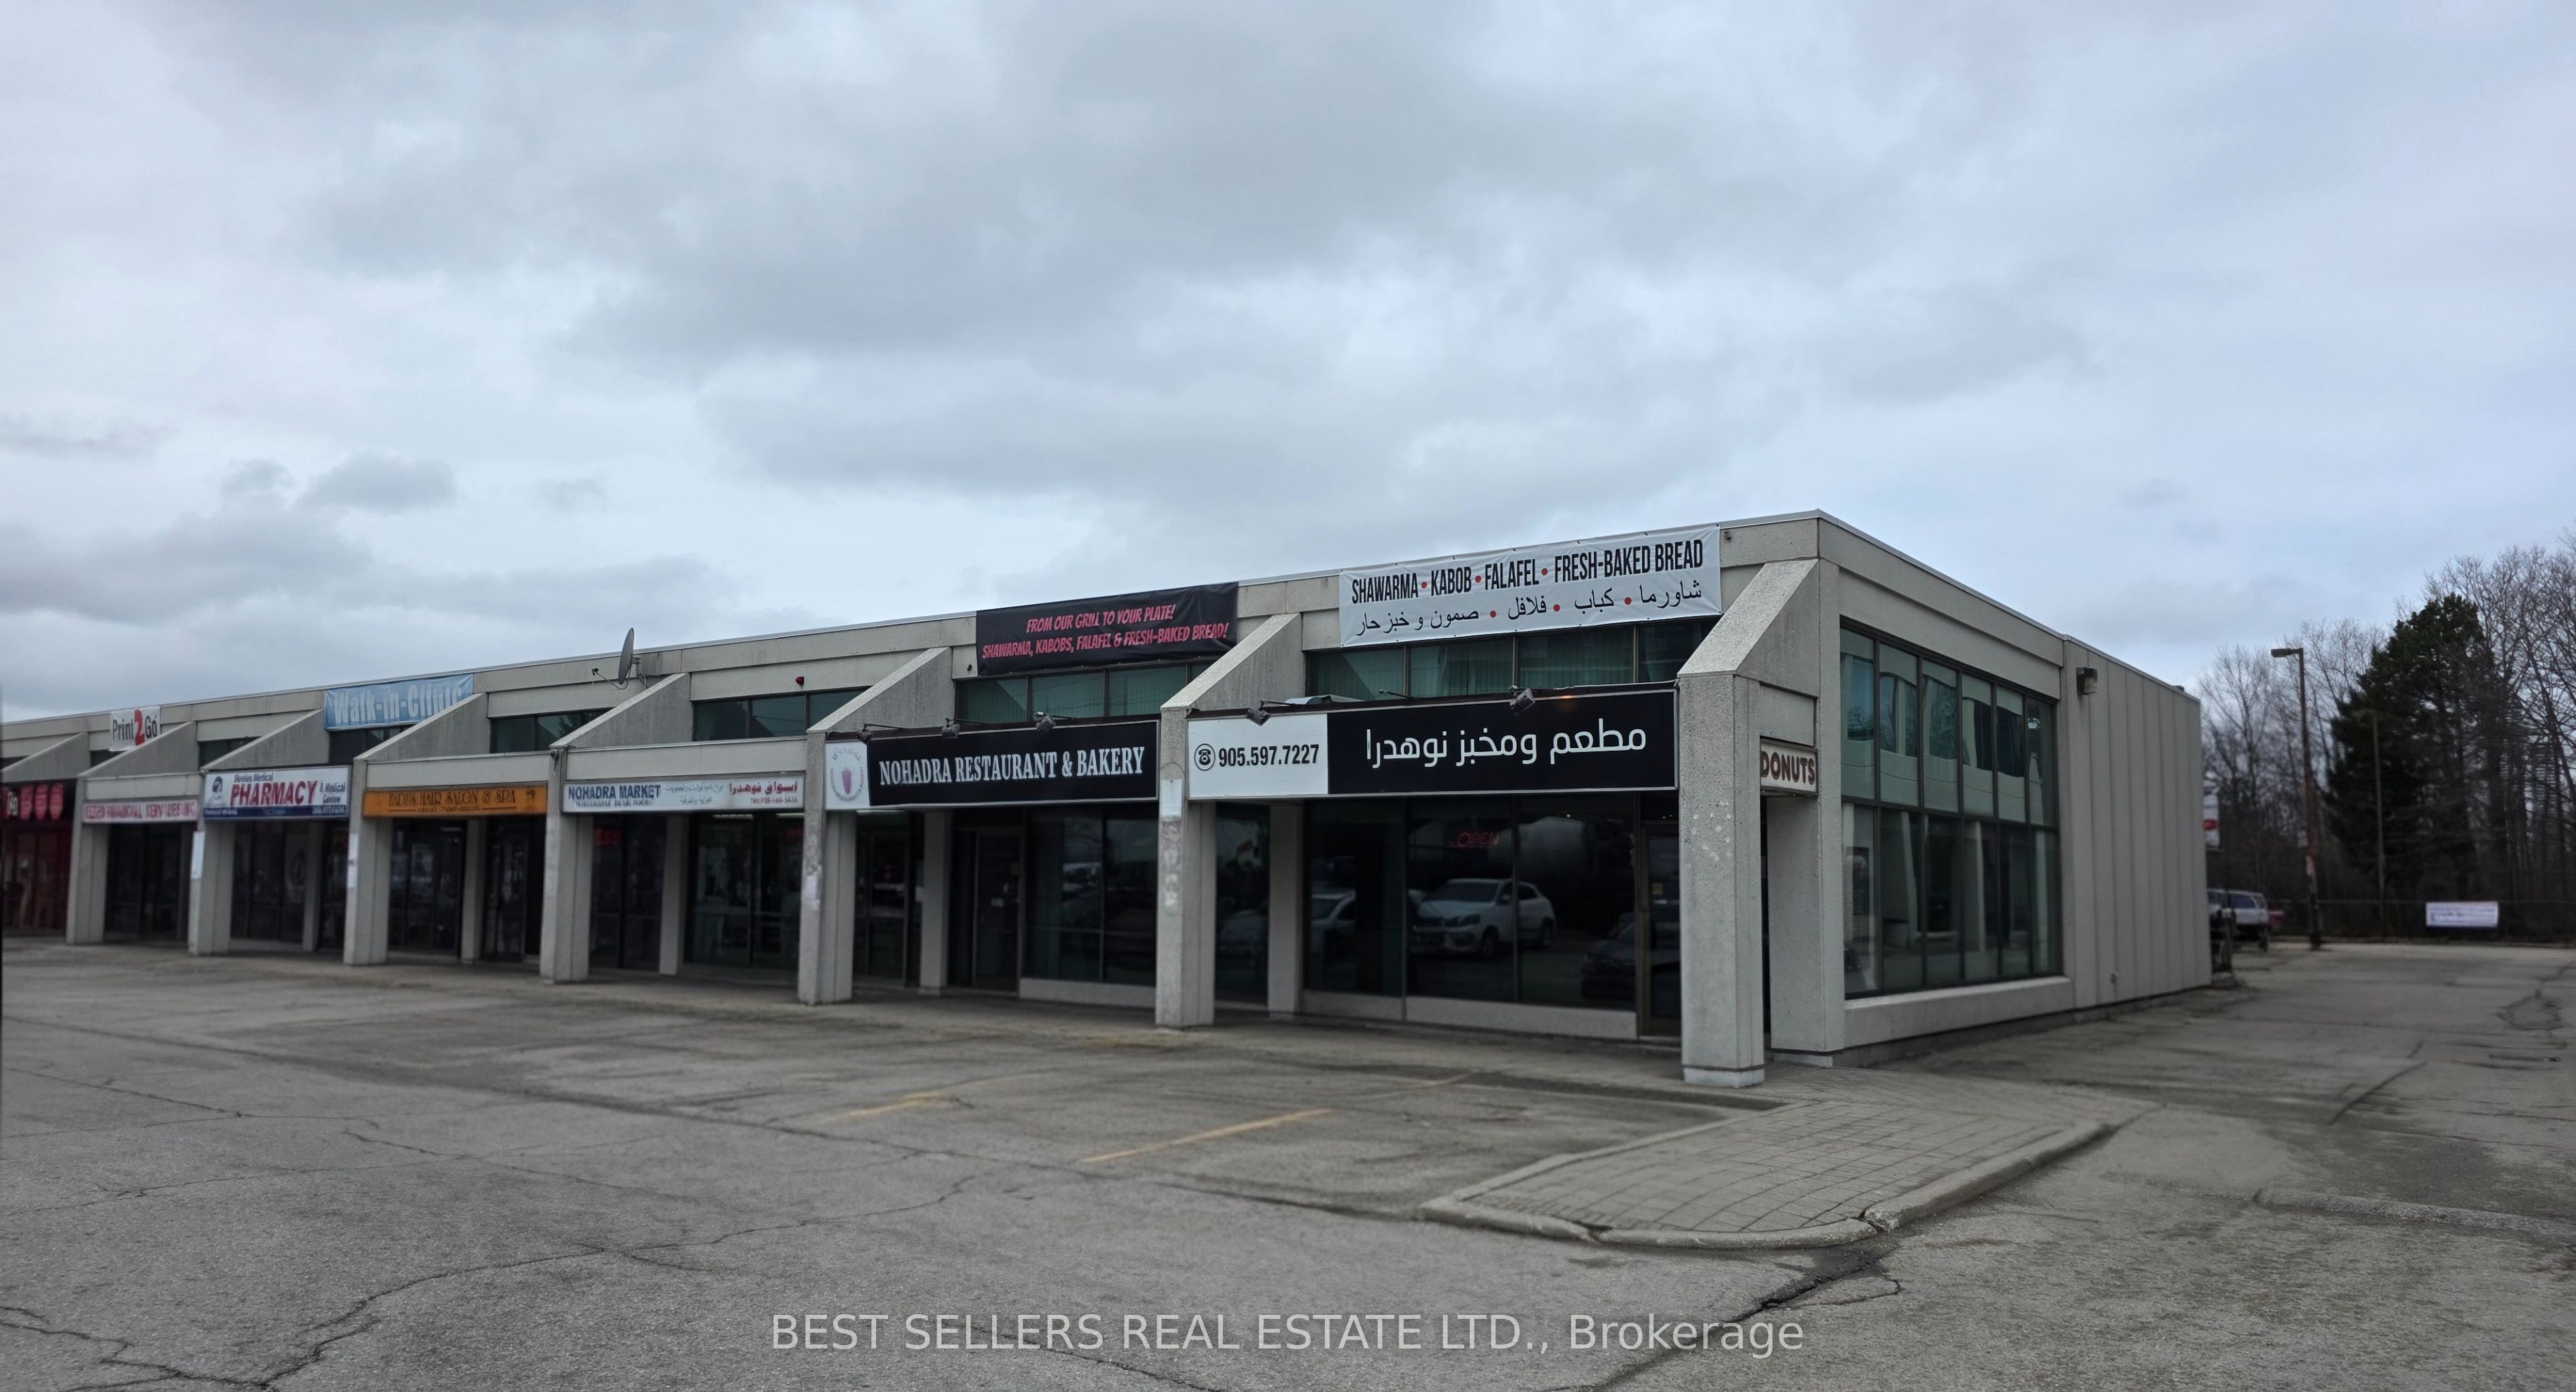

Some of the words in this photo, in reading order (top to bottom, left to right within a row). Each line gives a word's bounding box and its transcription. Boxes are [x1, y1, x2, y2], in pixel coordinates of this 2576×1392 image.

[1352, 573, 1418, 604] SHAWARMA
[1431, 566, 1472, 596] KABOB
[1485, 559, 1540, 590] FALAFEL
[1554, 545, 1651, 583] FRESH-BAKED
[1655, 539, 1703, 572] BREAD
[1574, 587, 1615, 614] كباب
[1639, 579, 1702, 609] شاورما
[1026, 616, 1053, 633] FROM
[1054, 614, 1073, 631] OUR
[1075, 612, 1100, 629] GRILL
[1102, 611, 1116, 626] TO
[1116, 607, 1142, 625] YOUR
[1144, 604, 1177, 621] PLATE!
[1508, 594, 1548, 620] فلافل
[1355, 612, 1381, 636] حار
[1383, 611, 1409, 633] خبز
[1413, 617, 1424, 631] و
[1430, 610, 1479, 629] صمون
[982, 641, 1034, 659] SHAWARMA,
[1035, 637, 1075, 655] KABOBS,
[1076, 633, 1112, 649] FALAFEL
[1114, 633, 1122, 647] &
[1123, 627, 1190, 645] FRESH-BAKED
[1191, 622, 1229, 641] BREAD!
[1366, 729, 1448, 769] نوهدرا
[1456, 727, 1537, 767] ومخبز
[1550, 718, 1647, 765] مطعم
[879, 757, 953, 786] NOHADRA
[955, 751, 1057, 782] RESTAURANT
[1061, 751, 1073, 777] &
[1077, 747, 1145, 777] BAKERY
[1218, 743, 1320, 767] 905.597.7227
[253, 772, 274, 782] Medical
[1760, 751, 1815, 786] DONUTS
[229, 780, 319, 806] PHARMACY
[319, 784, 323, 792] &
[325, 782, 346, 793] Medical
[323, 794, 341, 804] Centre
[420, 791, 443, 806] HAIR
[447, 790, 479, 806] SALON
[494, 788, 516, 804] SPA
[568, 786, 616, 800] NOHADRA
[619, 784, 661, 798] MARKET
[145, 802, 181, 818] SERVICES
[575, 799, 612, 808] WHOLESALE
[614, 798, 631, 806] BULK
[632, 798, 651, 806] FOOD
[1457, 832, 1499, 847] OPEN
